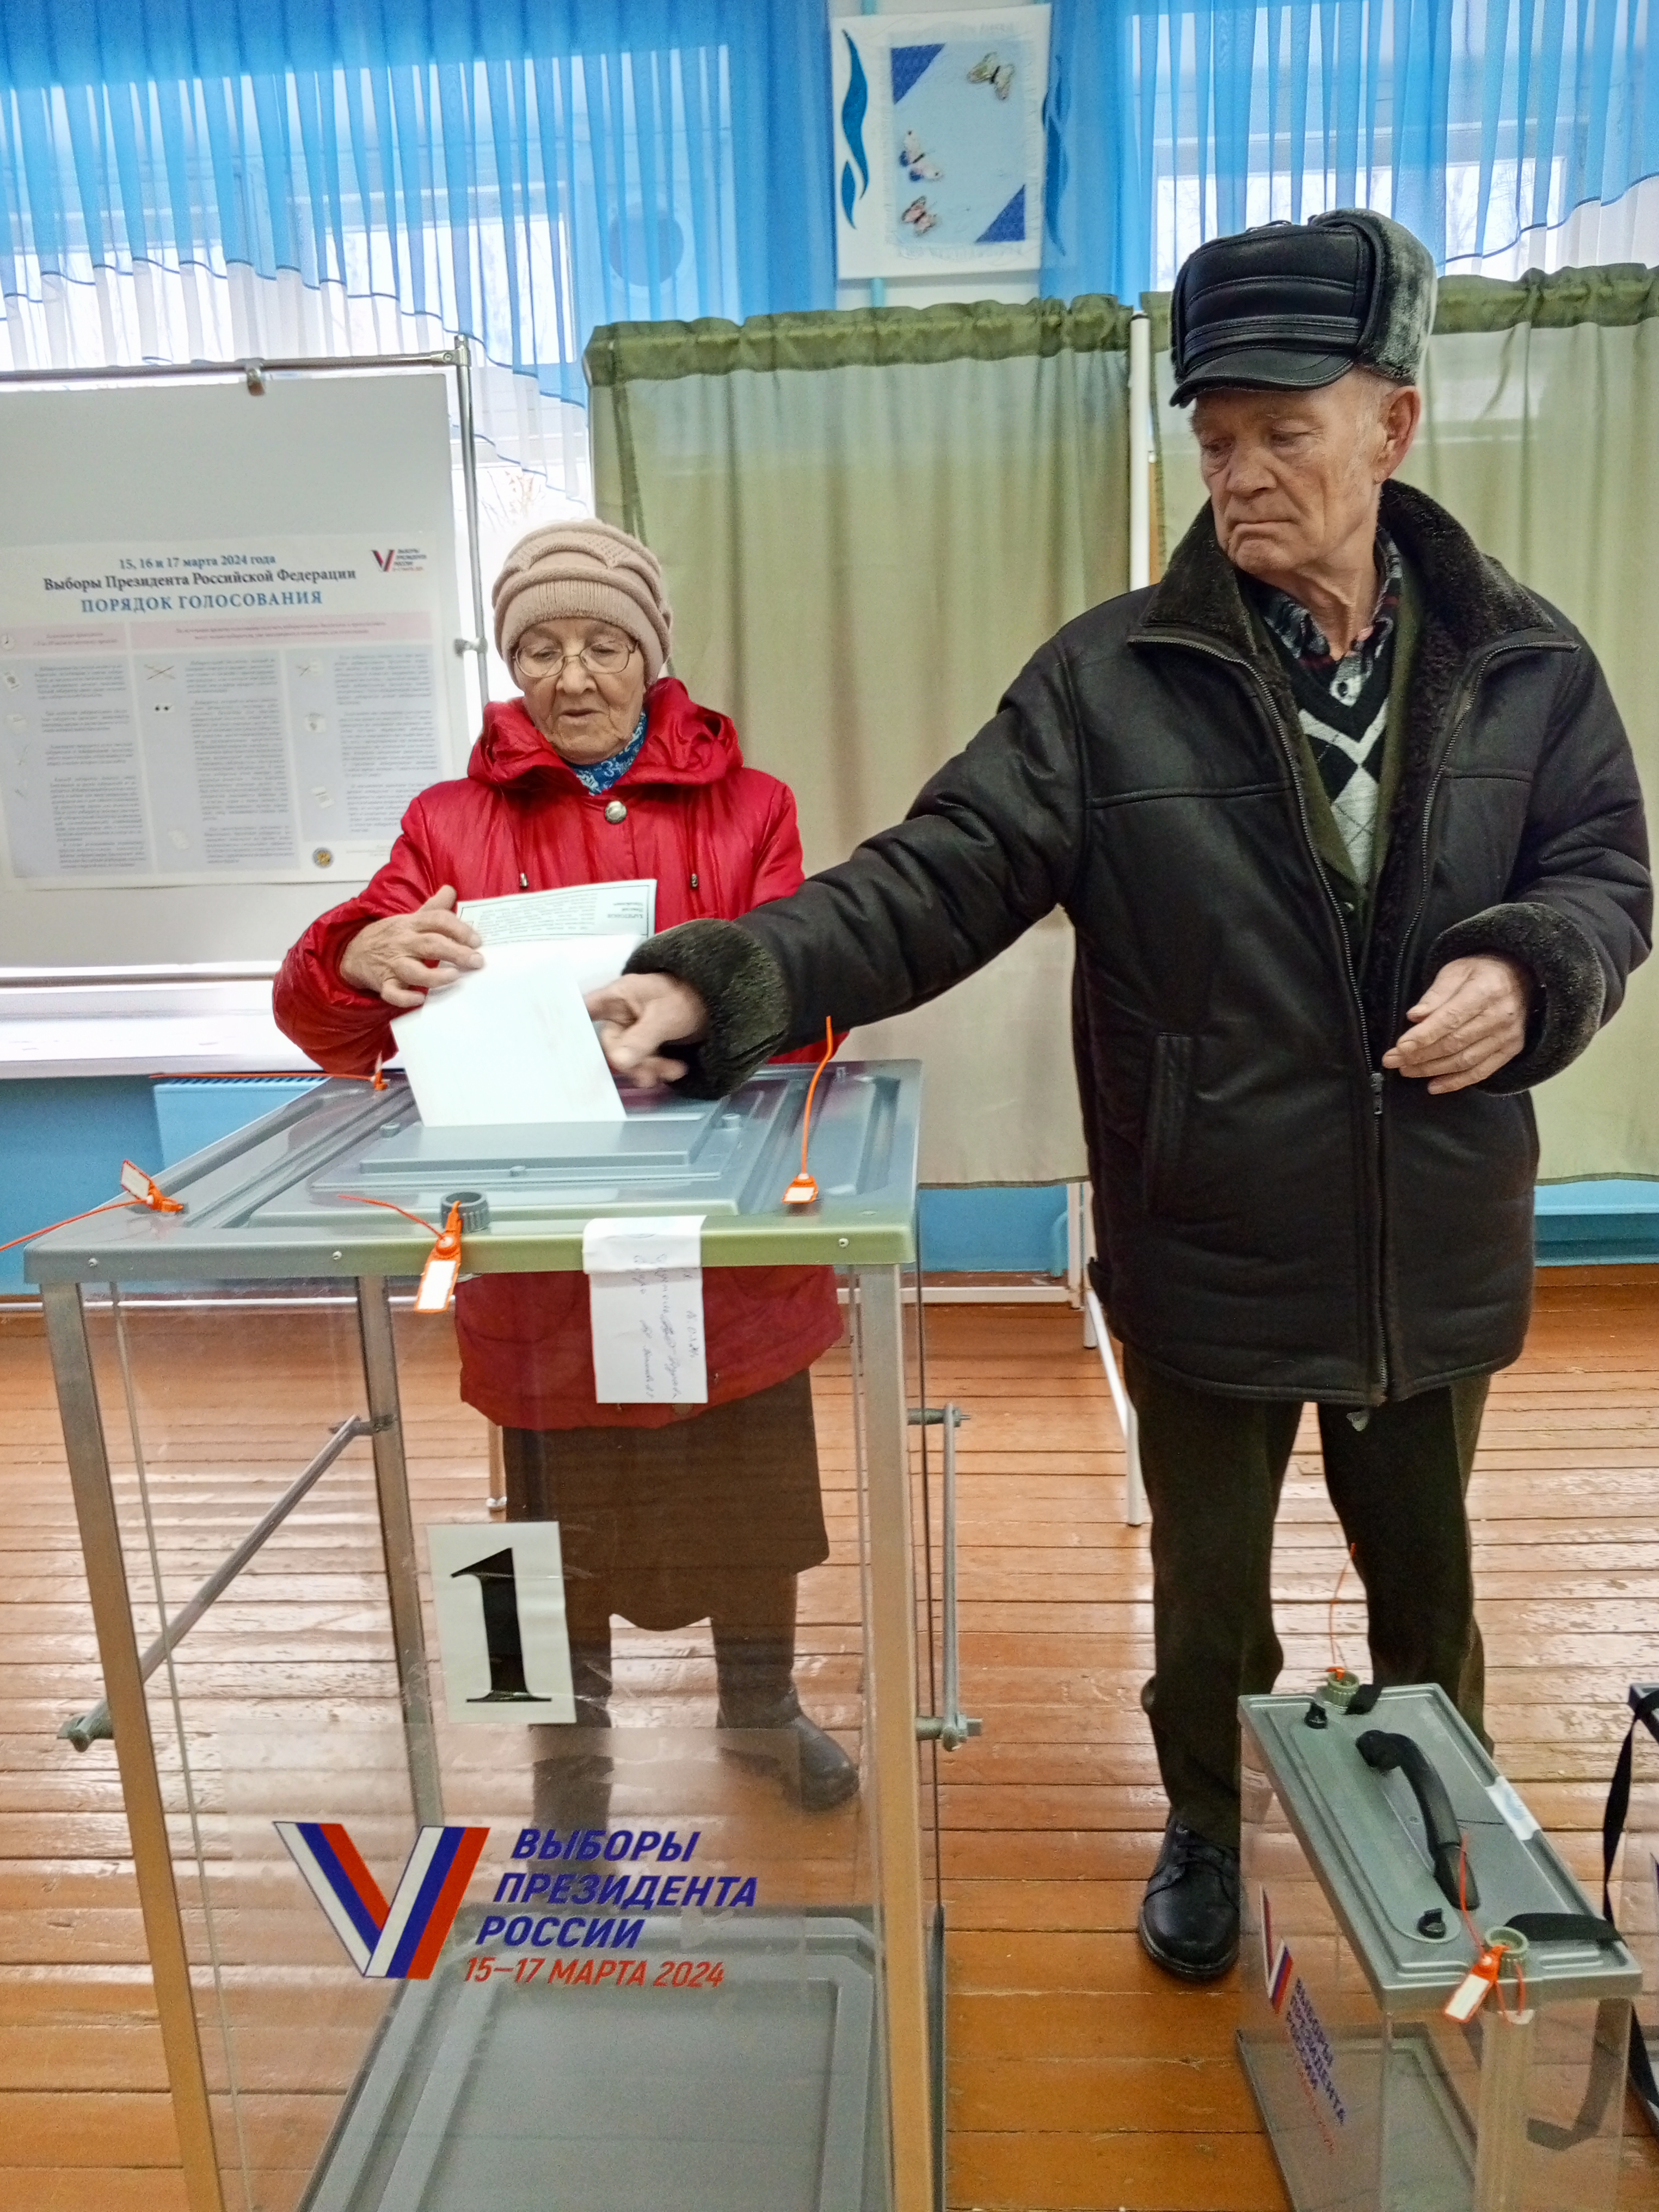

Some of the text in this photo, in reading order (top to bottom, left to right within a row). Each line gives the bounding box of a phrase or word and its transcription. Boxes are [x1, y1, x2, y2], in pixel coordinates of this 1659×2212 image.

[119, 555, 276, 570] 15, 16 и 17 марта 2024 года
[44, 569, 357, 592] Выборы Президента Российской Федерации
[82, 591, 322, 613] ПОРЯДОК ГОЛОСОВАНИЯ
[451, 1547, 552, 1702] 1
[511, 1829, 701, 1862] ВЫБОРЫ
[493, 1872, 758, 1910] ПРЕЗИДЕНТА
[476, 1915, 646, 1949] РОССИИ
[548, 1959, 647, 1986] МАРТА
[653, 1961, 725, 1988] 2024
